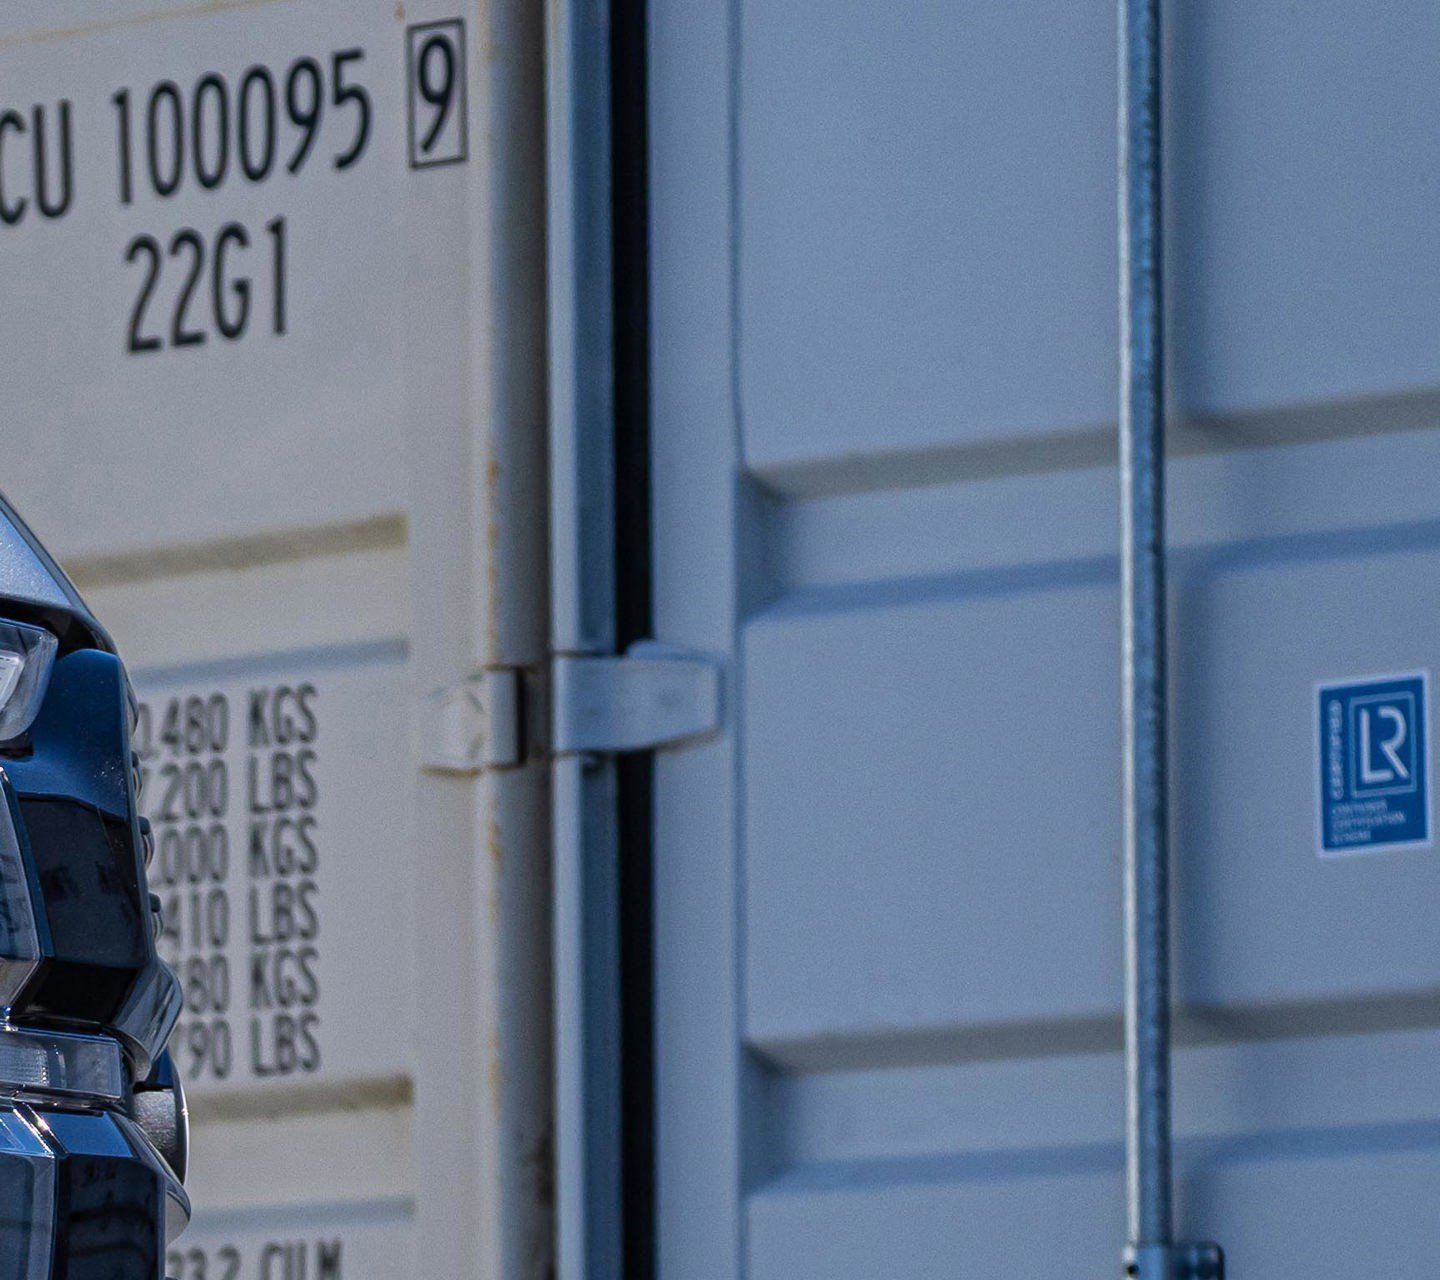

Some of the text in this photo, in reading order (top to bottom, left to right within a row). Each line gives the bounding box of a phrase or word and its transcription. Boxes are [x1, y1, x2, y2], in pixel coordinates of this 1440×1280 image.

[111, 47, 374, 205] 100095
[417, 32, 457, 155] 9
[124, 216, 288, 355] 22G1
[248, 682, 317, 747] KGS
[248, 749, 318, 815] LBS
[248, 815, 318, 879] KGS
[249, 879, 320, 945] LBS
[171, 946, 320, 1014] 80 KGS
[250, 1010, 321, 1077] LBS
